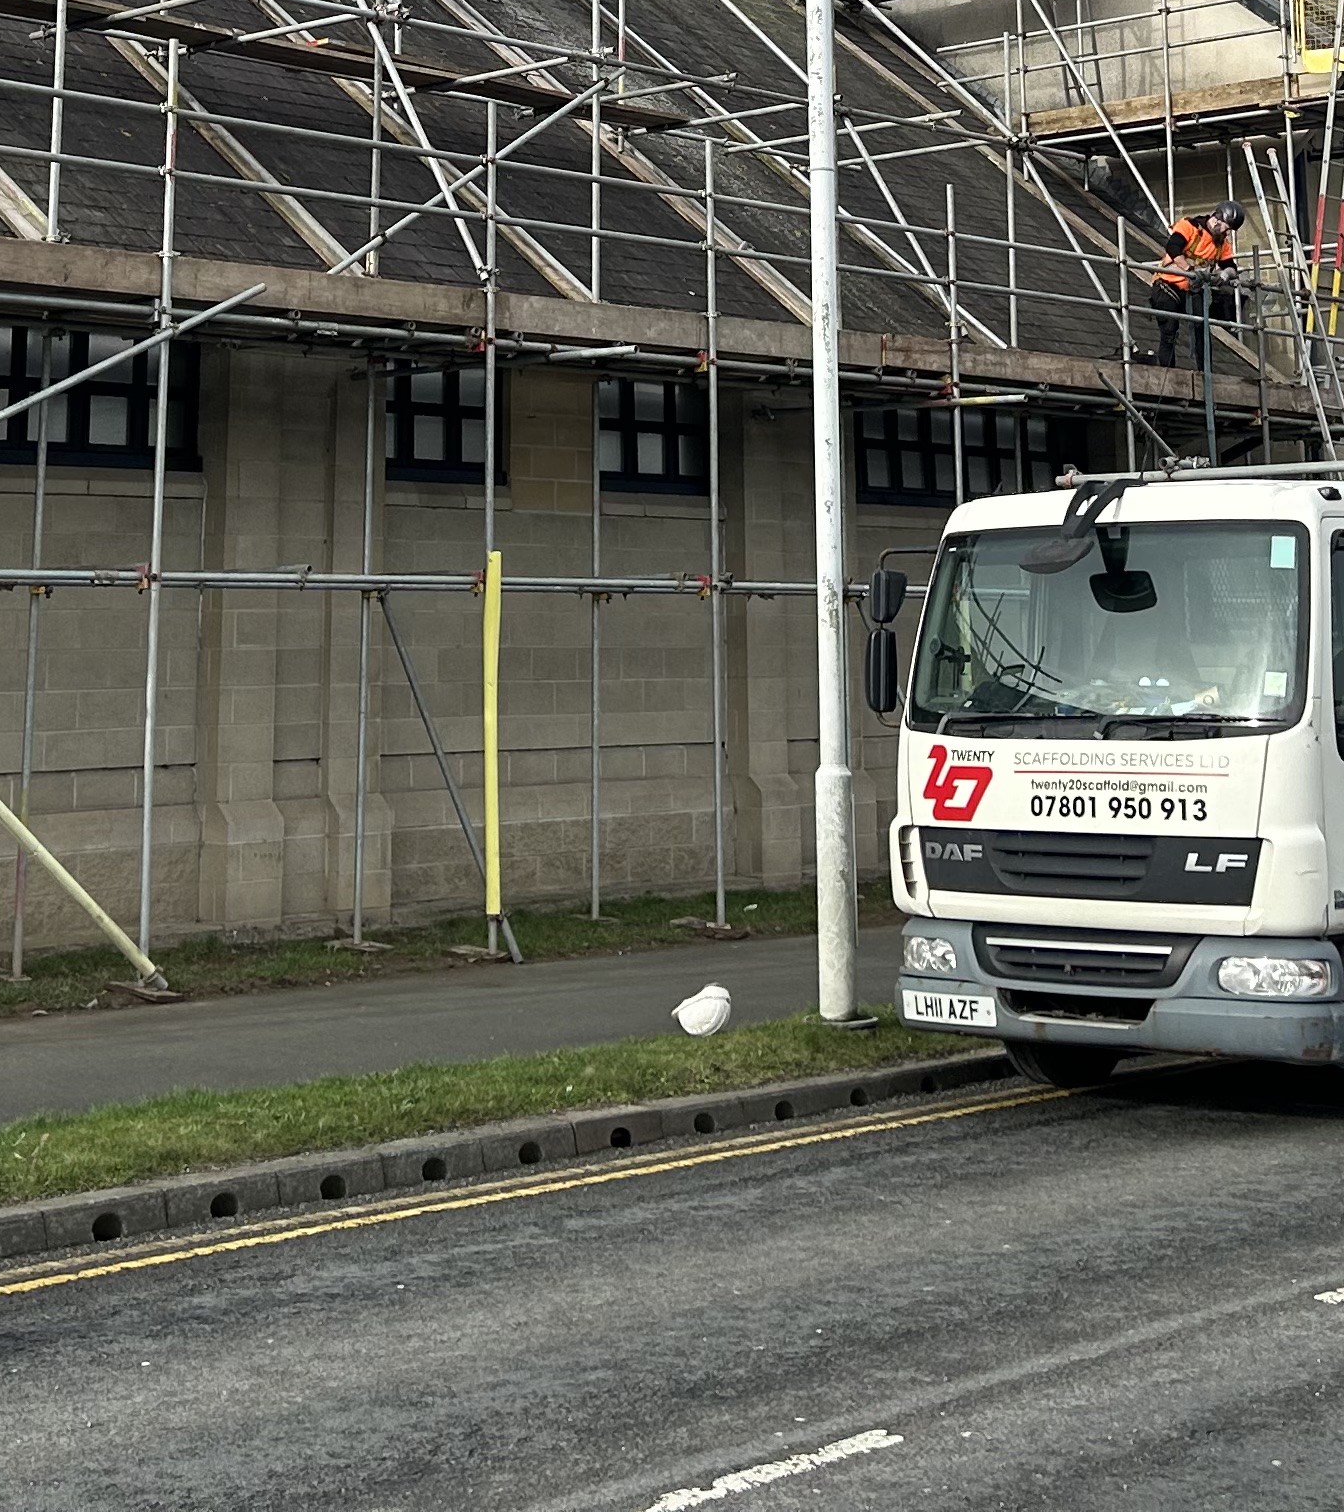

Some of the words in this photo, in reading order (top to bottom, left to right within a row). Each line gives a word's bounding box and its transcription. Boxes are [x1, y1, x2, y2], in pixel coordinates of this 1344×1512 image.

[951, 749, 995, 762] TWENTY
[1013, 752, 1115, 767] SCAFFOLDING
[1120, 753, 1194, 768] SERVICES
[1199, 755, 1230, 769] LTD
[1030, 794, 1096, 818] 07801
[1108, 796, 1152, 819] 950
[1160, 797, 1208, 822] 913
[925, 841, 983, 862] DAF
[1184, 852, 1249, 873] LF
[914, 995, 943, 1018] LH11
[948, 998, 979, 1021] AZF
